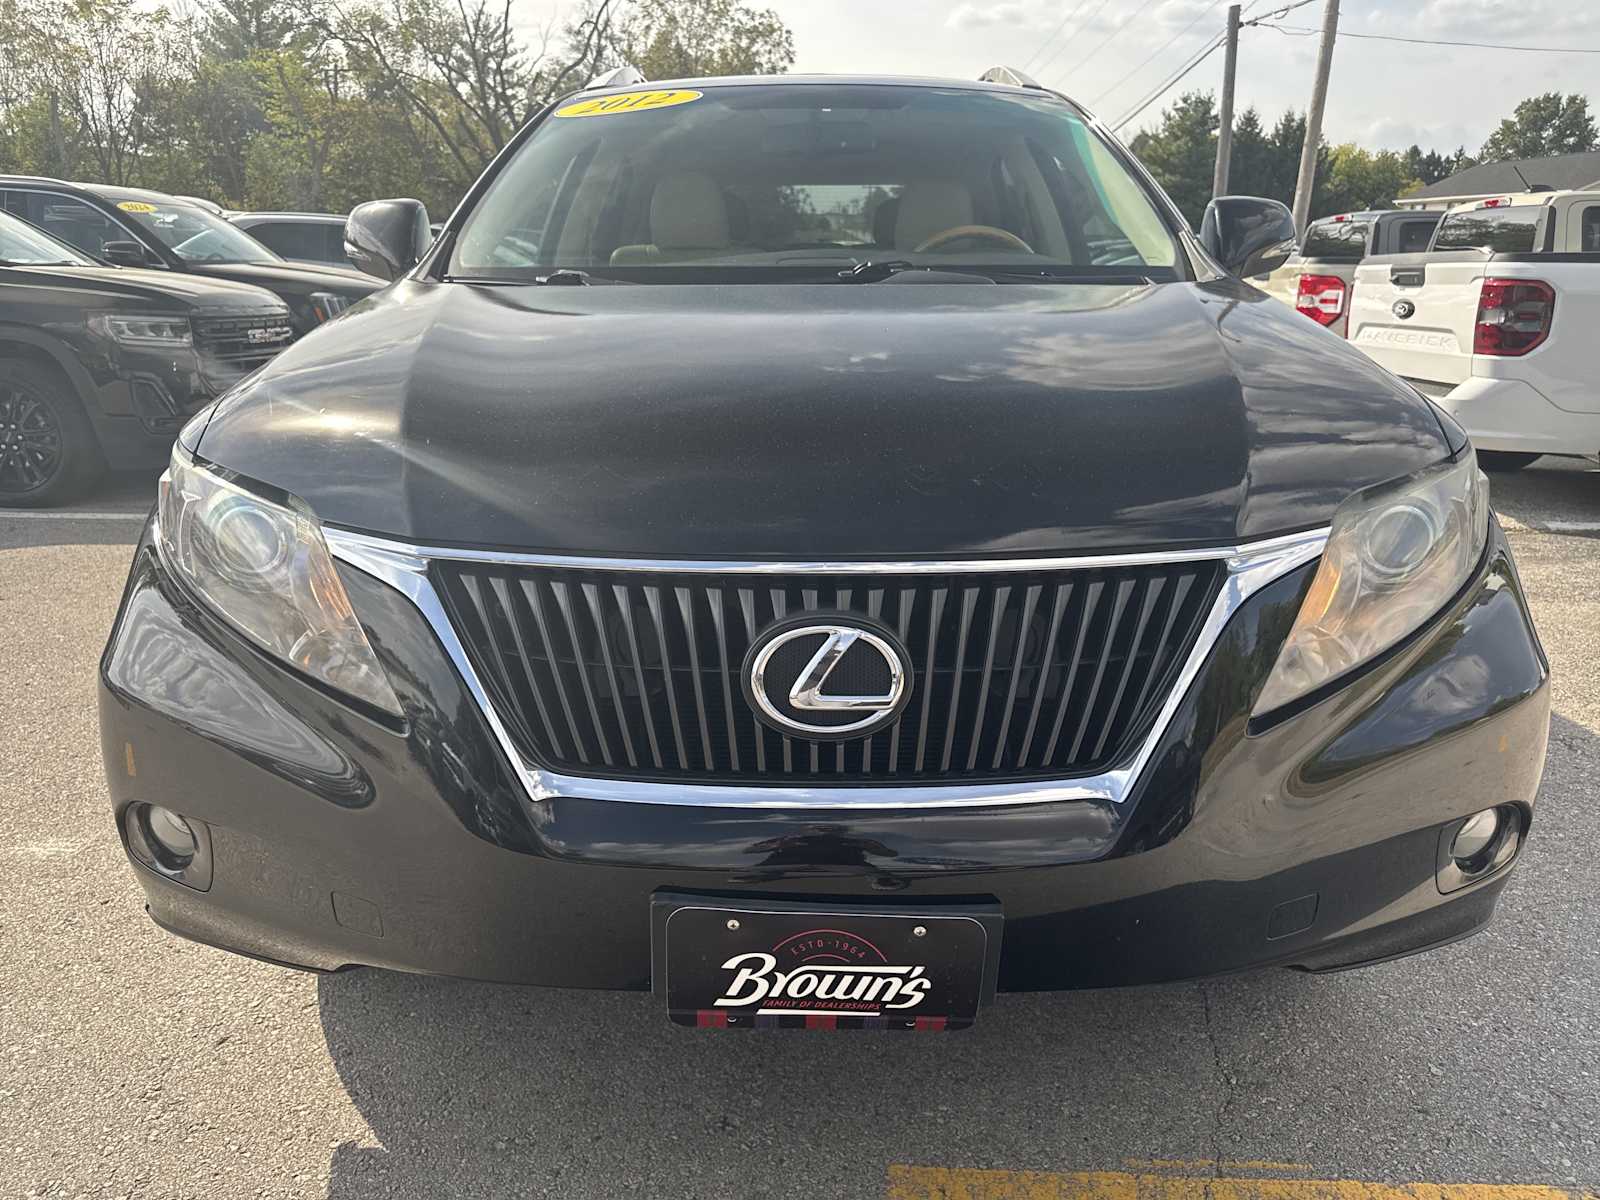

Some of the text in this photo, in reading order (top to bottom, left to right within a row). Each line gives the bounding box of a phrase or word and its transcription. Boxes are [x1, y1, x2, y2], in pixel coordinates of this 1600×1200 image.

[575, 92, 677, 114] 2012
[713, 952, 932, 1009] Brown's
[762, 1000, 881, 1010] FAMILY OF DEALERSHIPS
